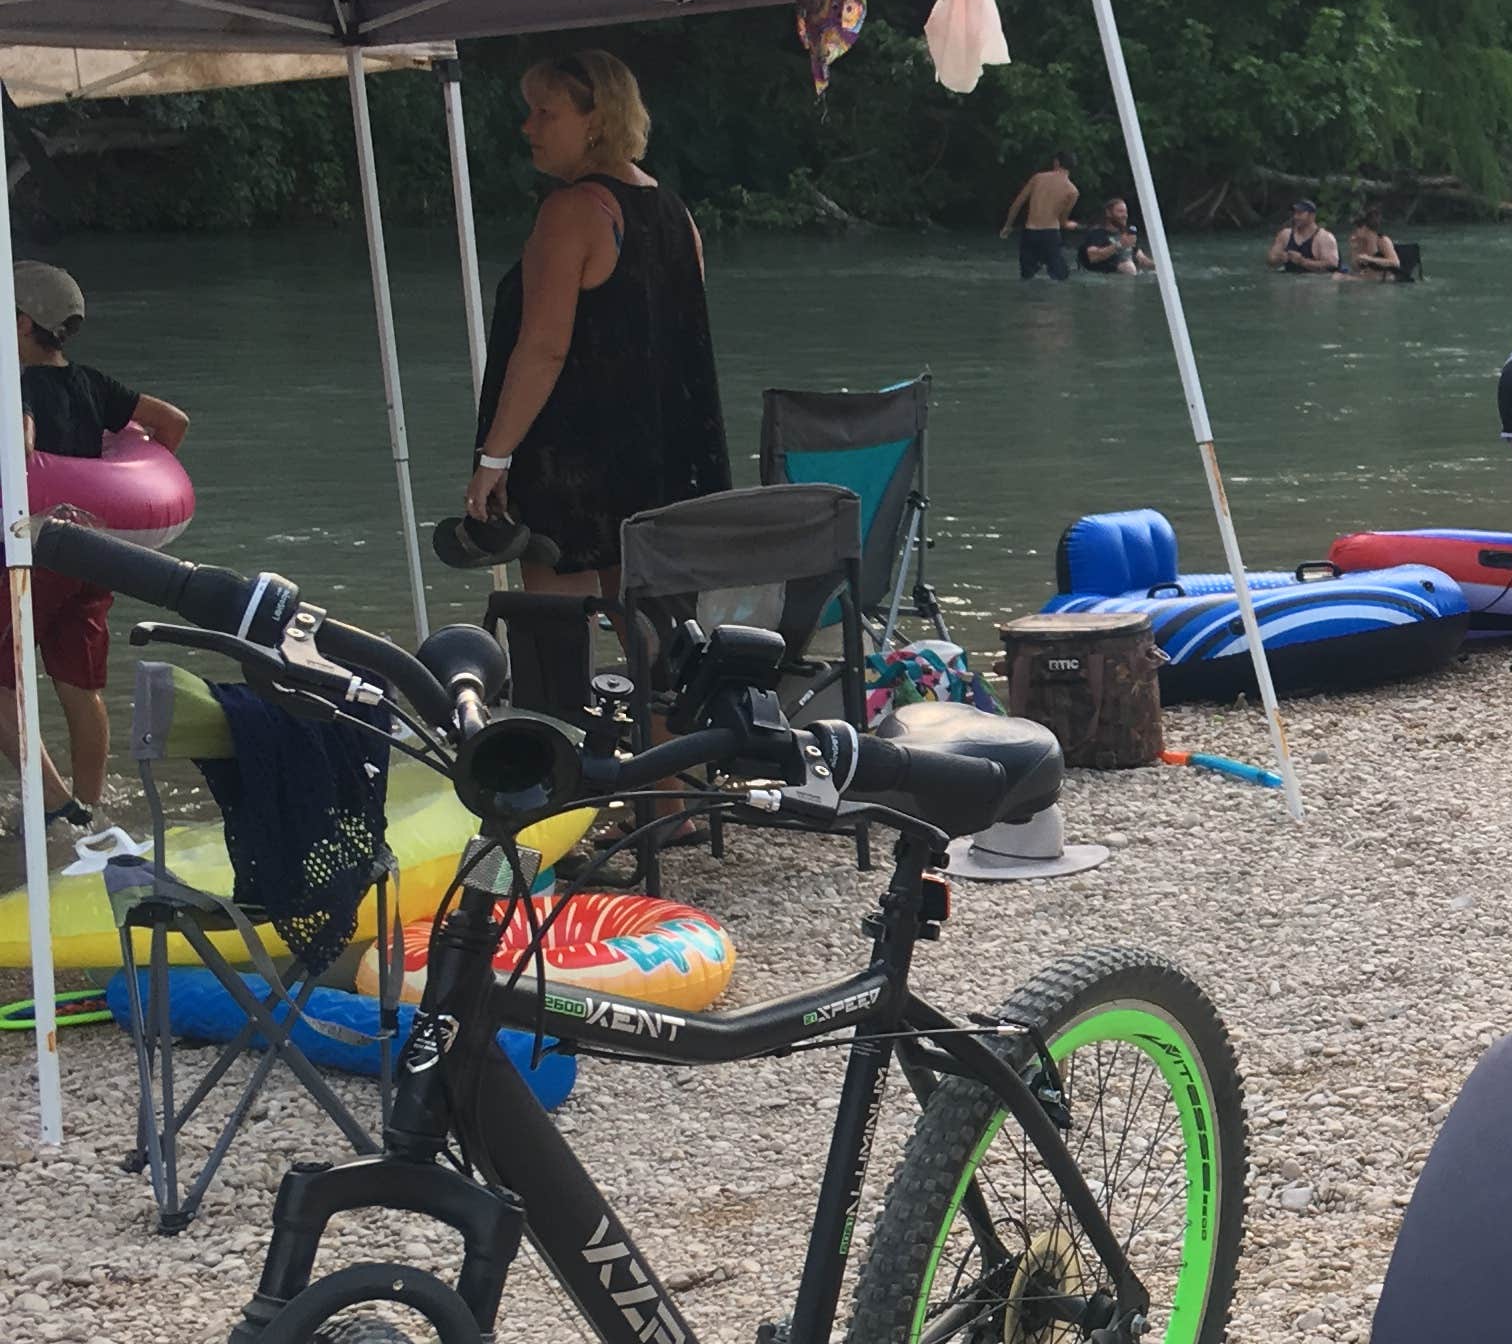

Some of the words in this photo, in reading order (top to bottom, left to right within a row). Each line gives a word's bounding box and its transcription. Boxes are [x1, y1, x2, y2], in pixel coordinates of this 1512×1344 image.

[1048, 658, 1080, 671] RTIC
[585, 997, 687, 1042] KENT
[816, 986, 882, 1024] SPEED
[845, 1066, 888, 1216] ALUMINUM
